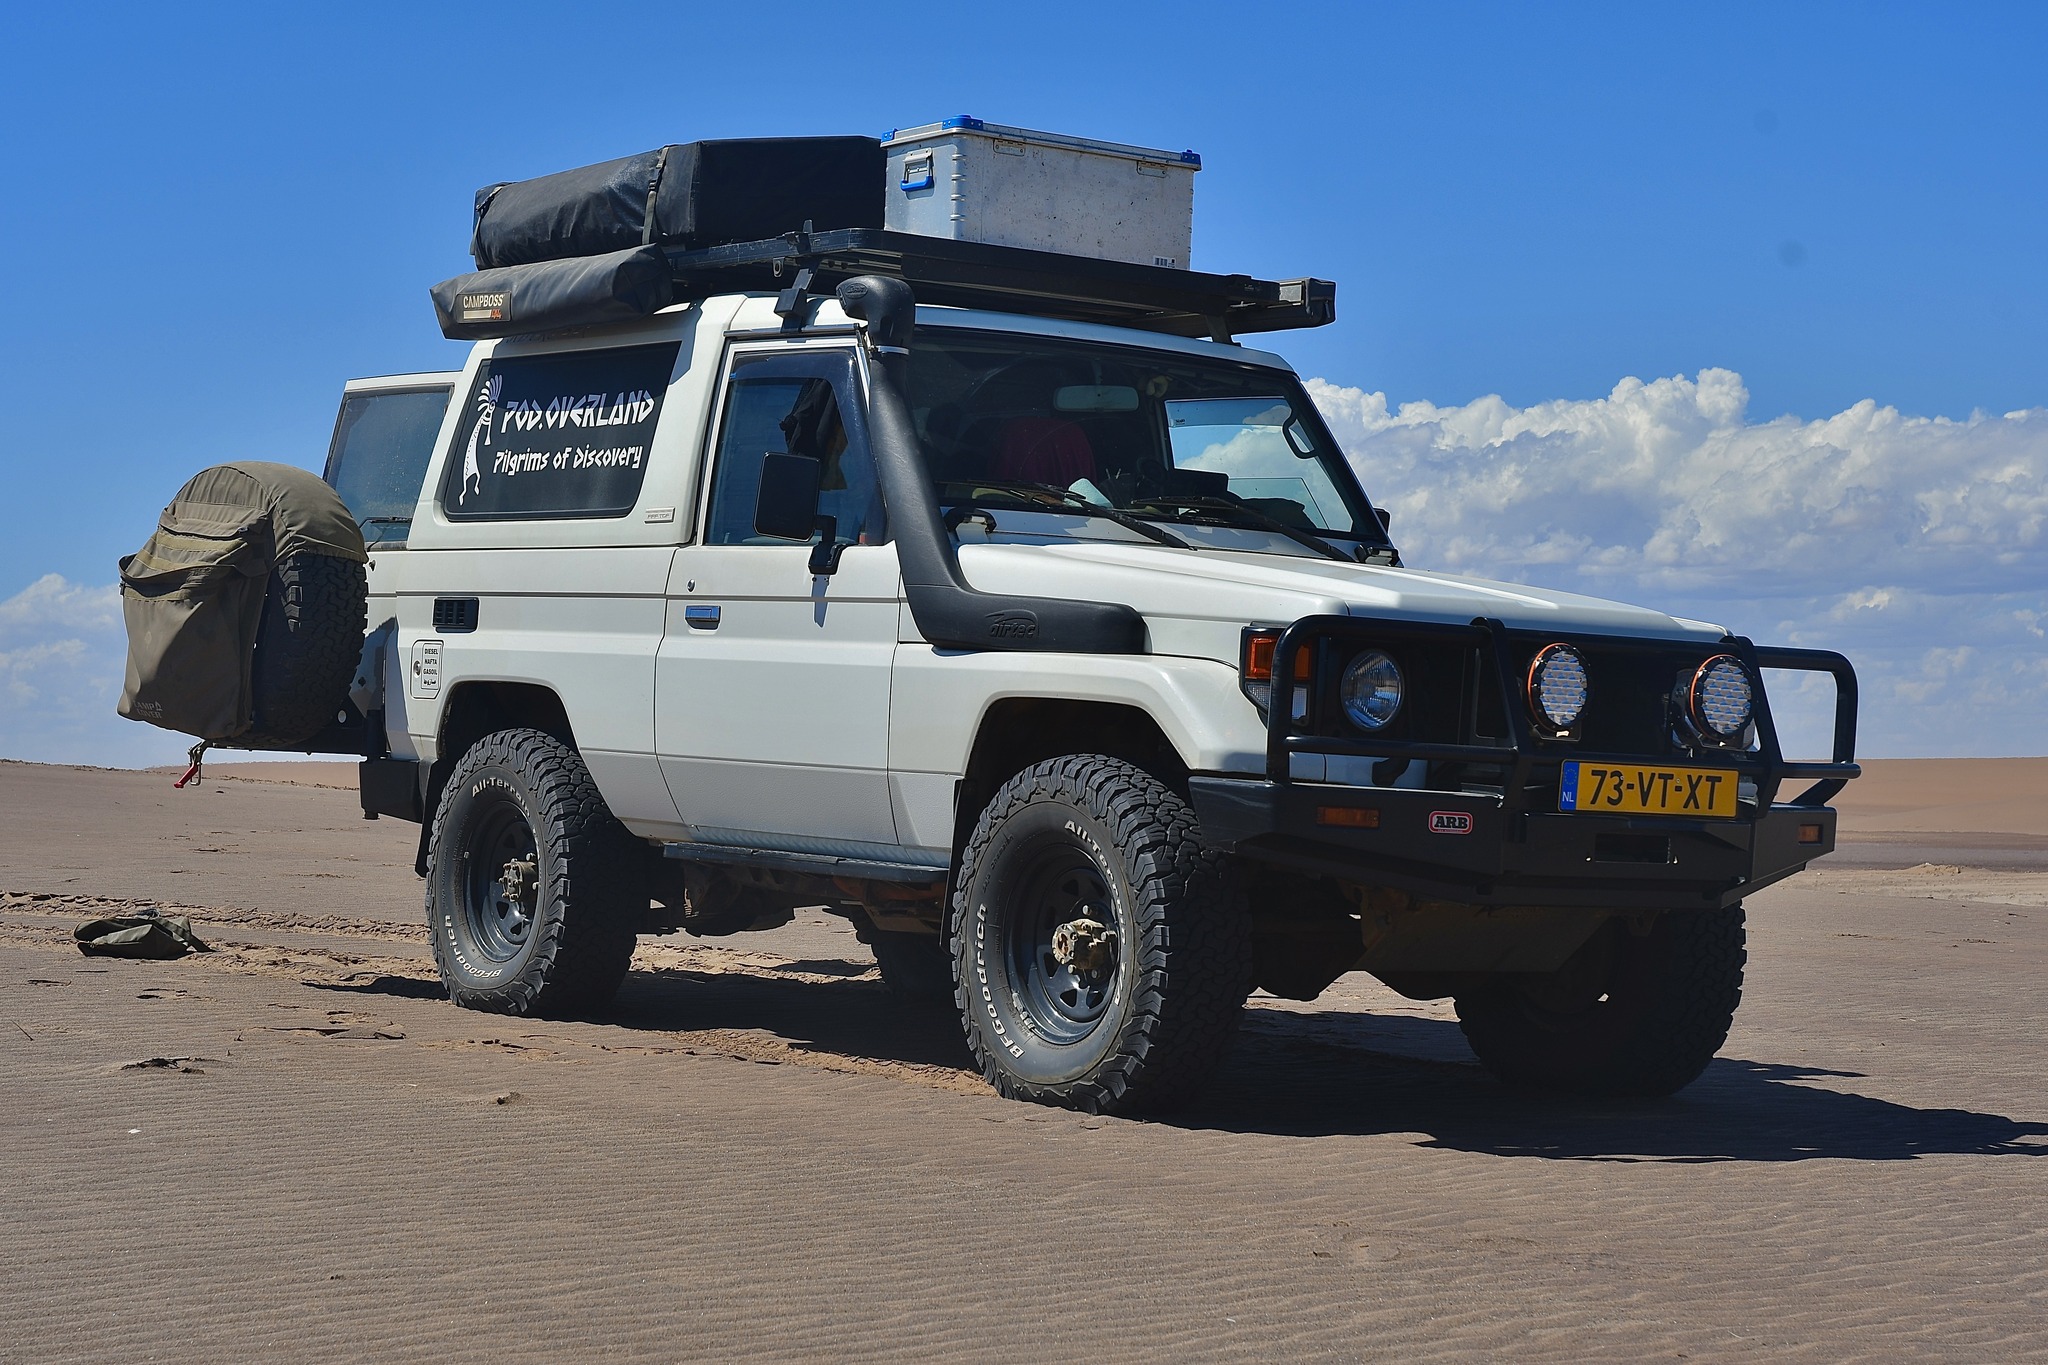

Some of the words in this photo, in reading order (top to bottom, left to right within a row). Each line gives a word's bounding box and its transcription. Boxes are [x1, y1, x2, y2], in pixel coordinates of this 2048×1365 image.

[463, 294, 504, 308] CAMPBOSS
[500, 389, 655, 434] POD.OVERLAND
[492, 446, 549, 476] Pilgrims
[552, 446, 572, 470] of
[573, 443, 644, 470] Discovery
[1562, 791, 1574, 803] NL
[1589, 769, 1723, 810] 73-VT-XT
[1434, 816, 1468, 829] ARB
[445, 914, 503, 978] BFGoodrich
[974, 903, 1026, 1060] BFGoodrich
